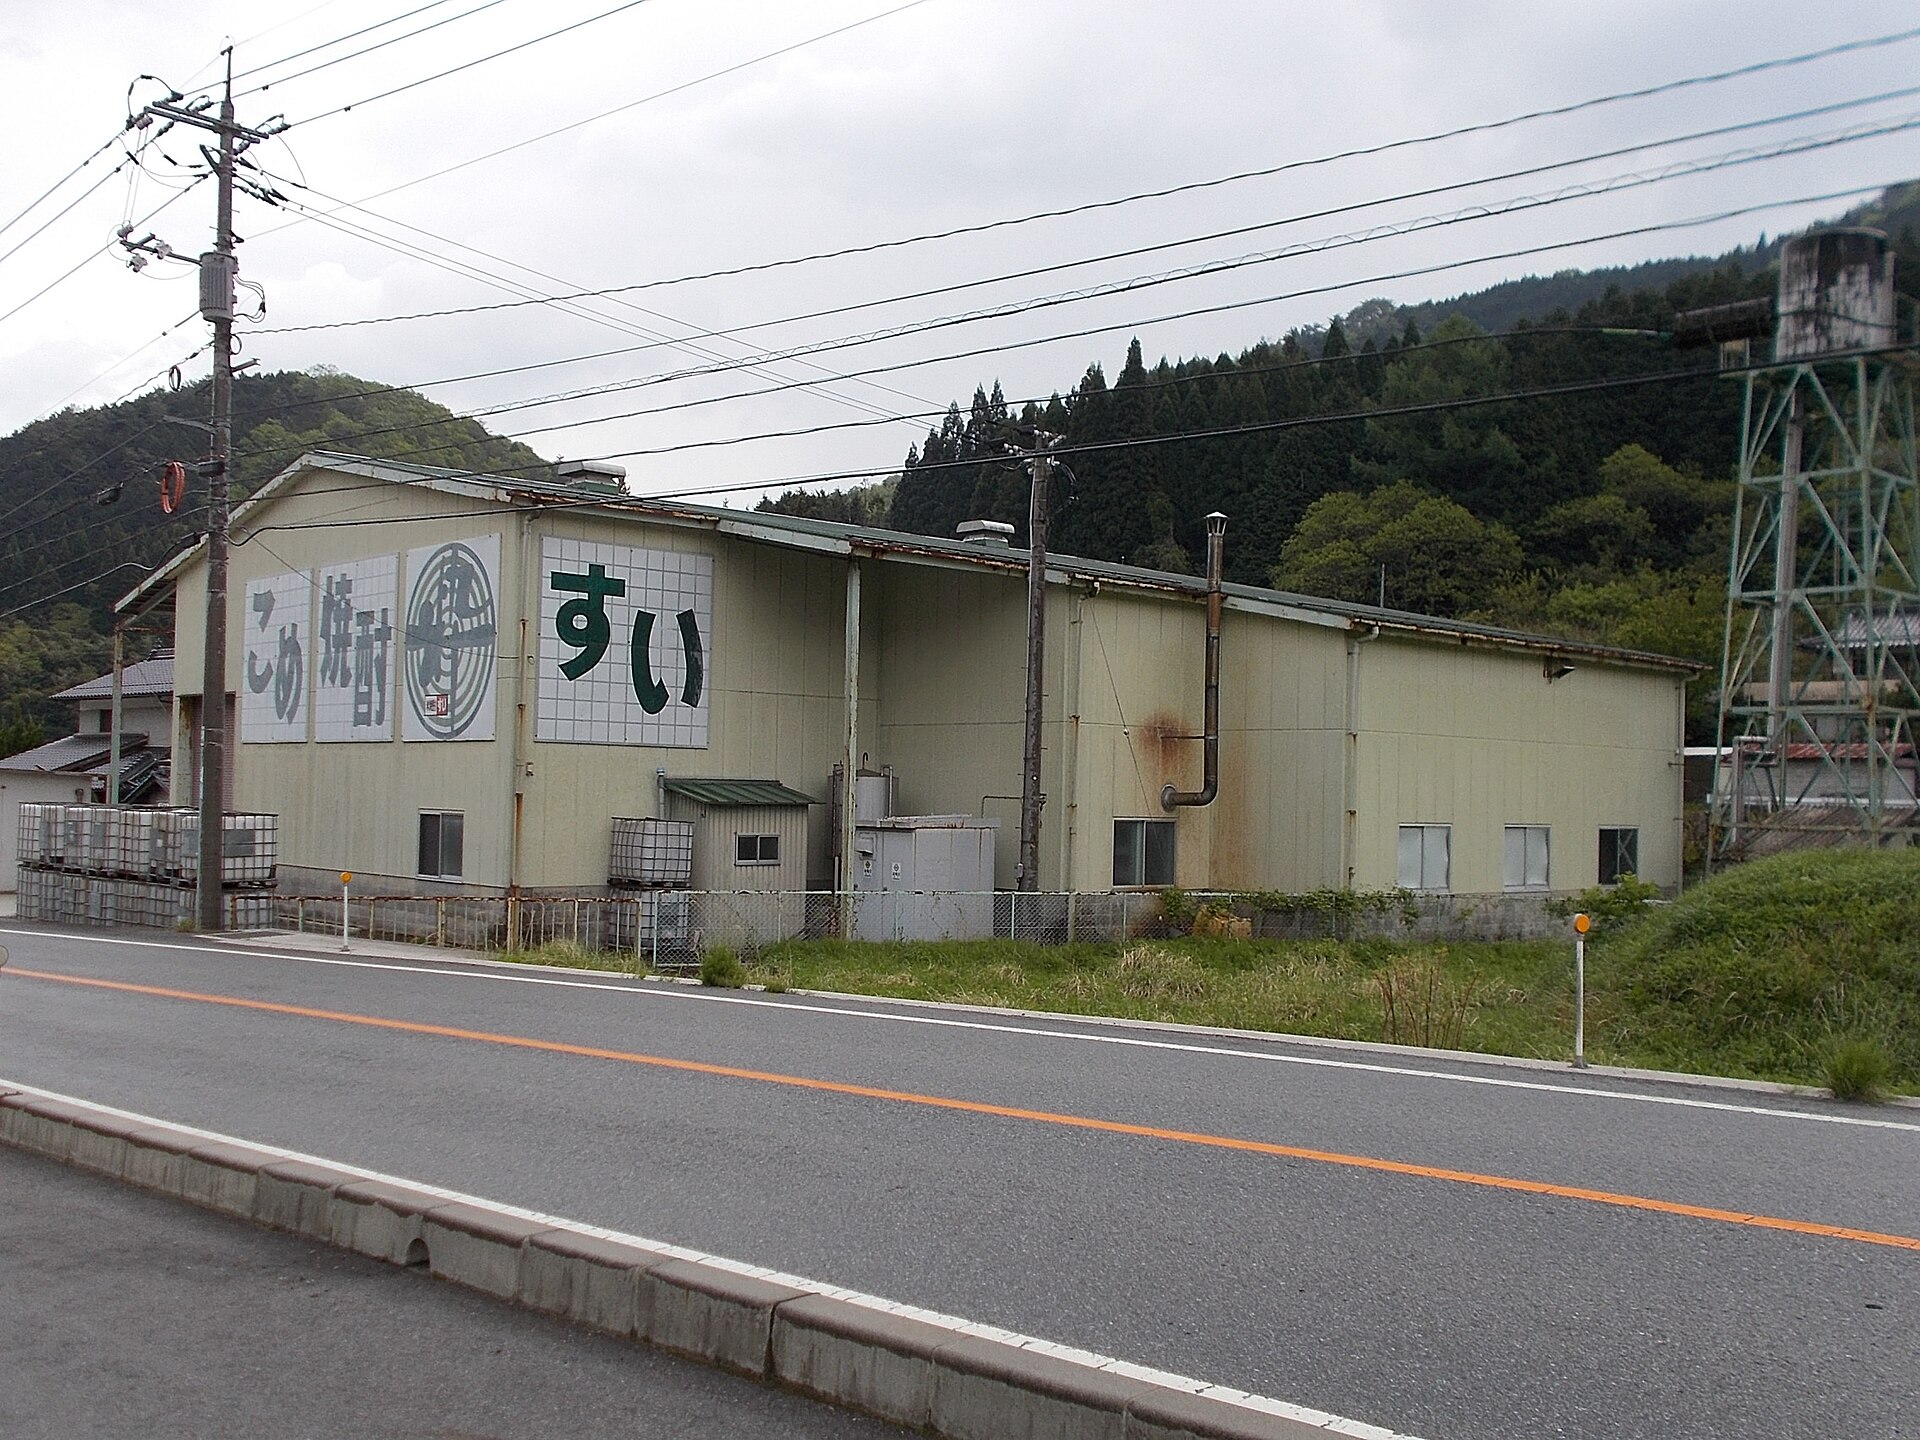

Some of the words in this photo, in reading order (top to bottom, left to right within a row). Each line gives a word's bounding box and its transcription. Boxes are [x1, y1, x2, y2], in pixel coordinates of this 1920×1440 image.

[248, 589, 303, 725] こめ
[320, 573, 393, 727] 焼酎
[551, 563, 704, 716] すい
